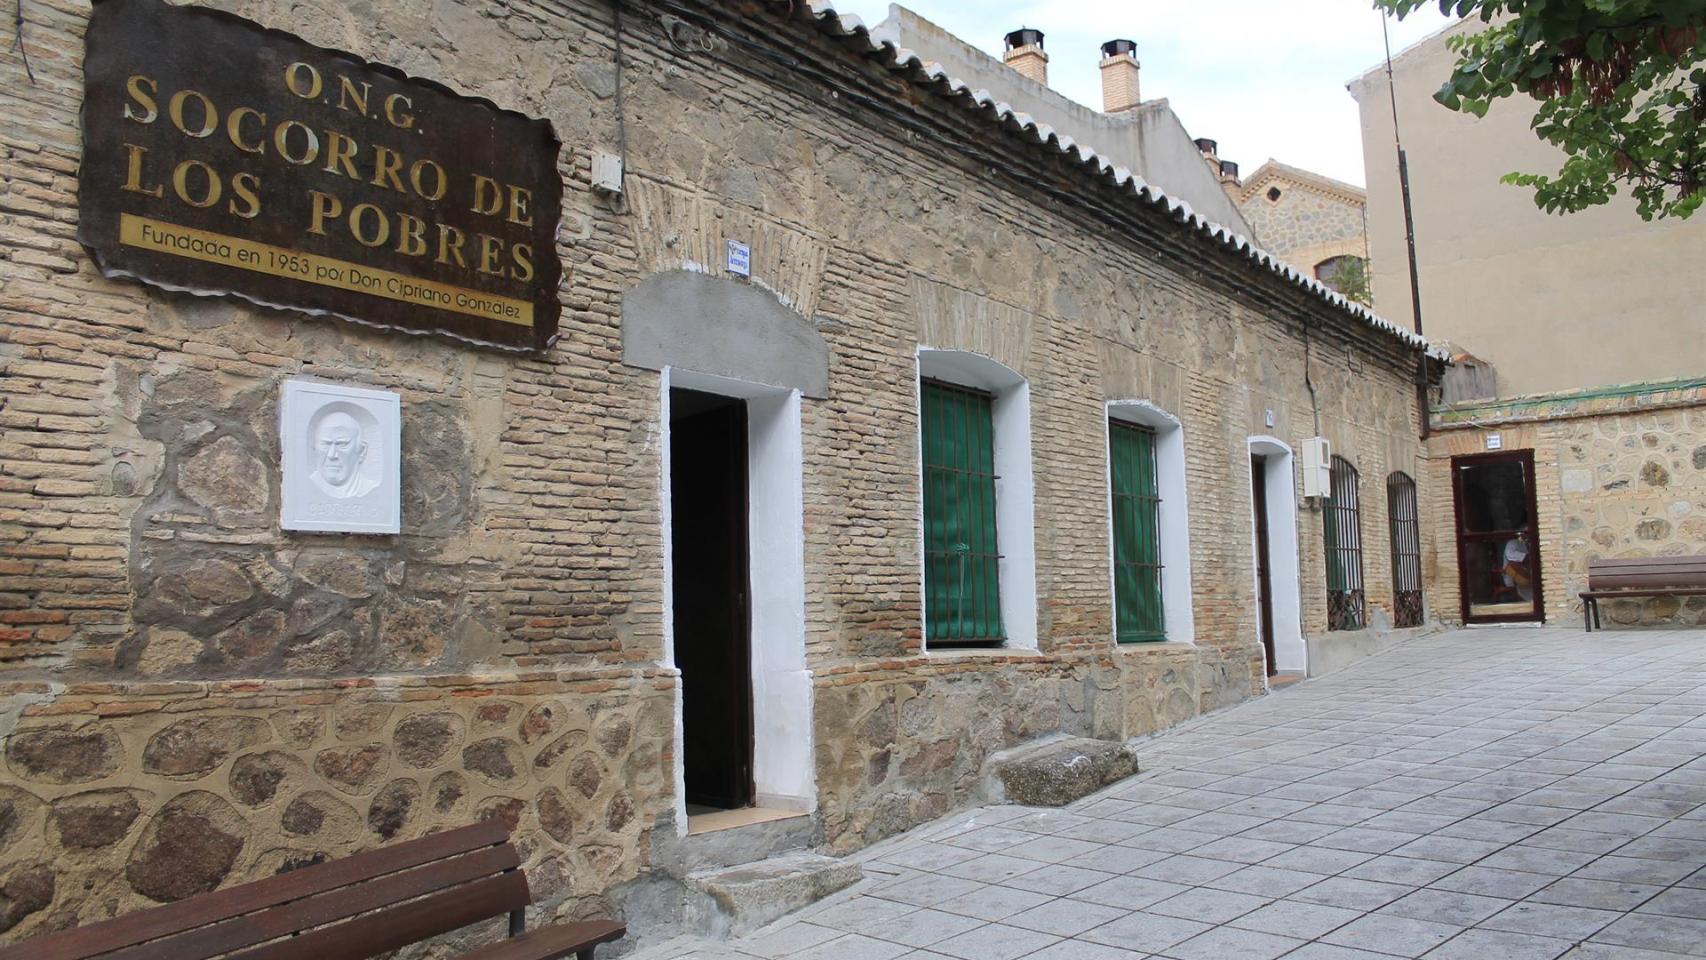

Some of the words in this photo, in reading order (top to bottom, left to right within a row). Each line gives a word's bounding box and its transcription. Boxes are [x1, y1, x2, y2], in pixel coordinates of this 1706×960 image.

[121, 143, 261, 219] LOS
[307, 190, 534, 283] POBRES
[123, 75, 448, 201] SOCORRO
[471, 174, 533, 228] DE
[142, 224, 231, 259] Fundada
[237, 248, 261, 265] en
[269, 251, 309, 275] 1953
[316, 264, 344, 282] por
[350, 269, 382, 289] Don
[386, 278, 451, 305] Cipriano
